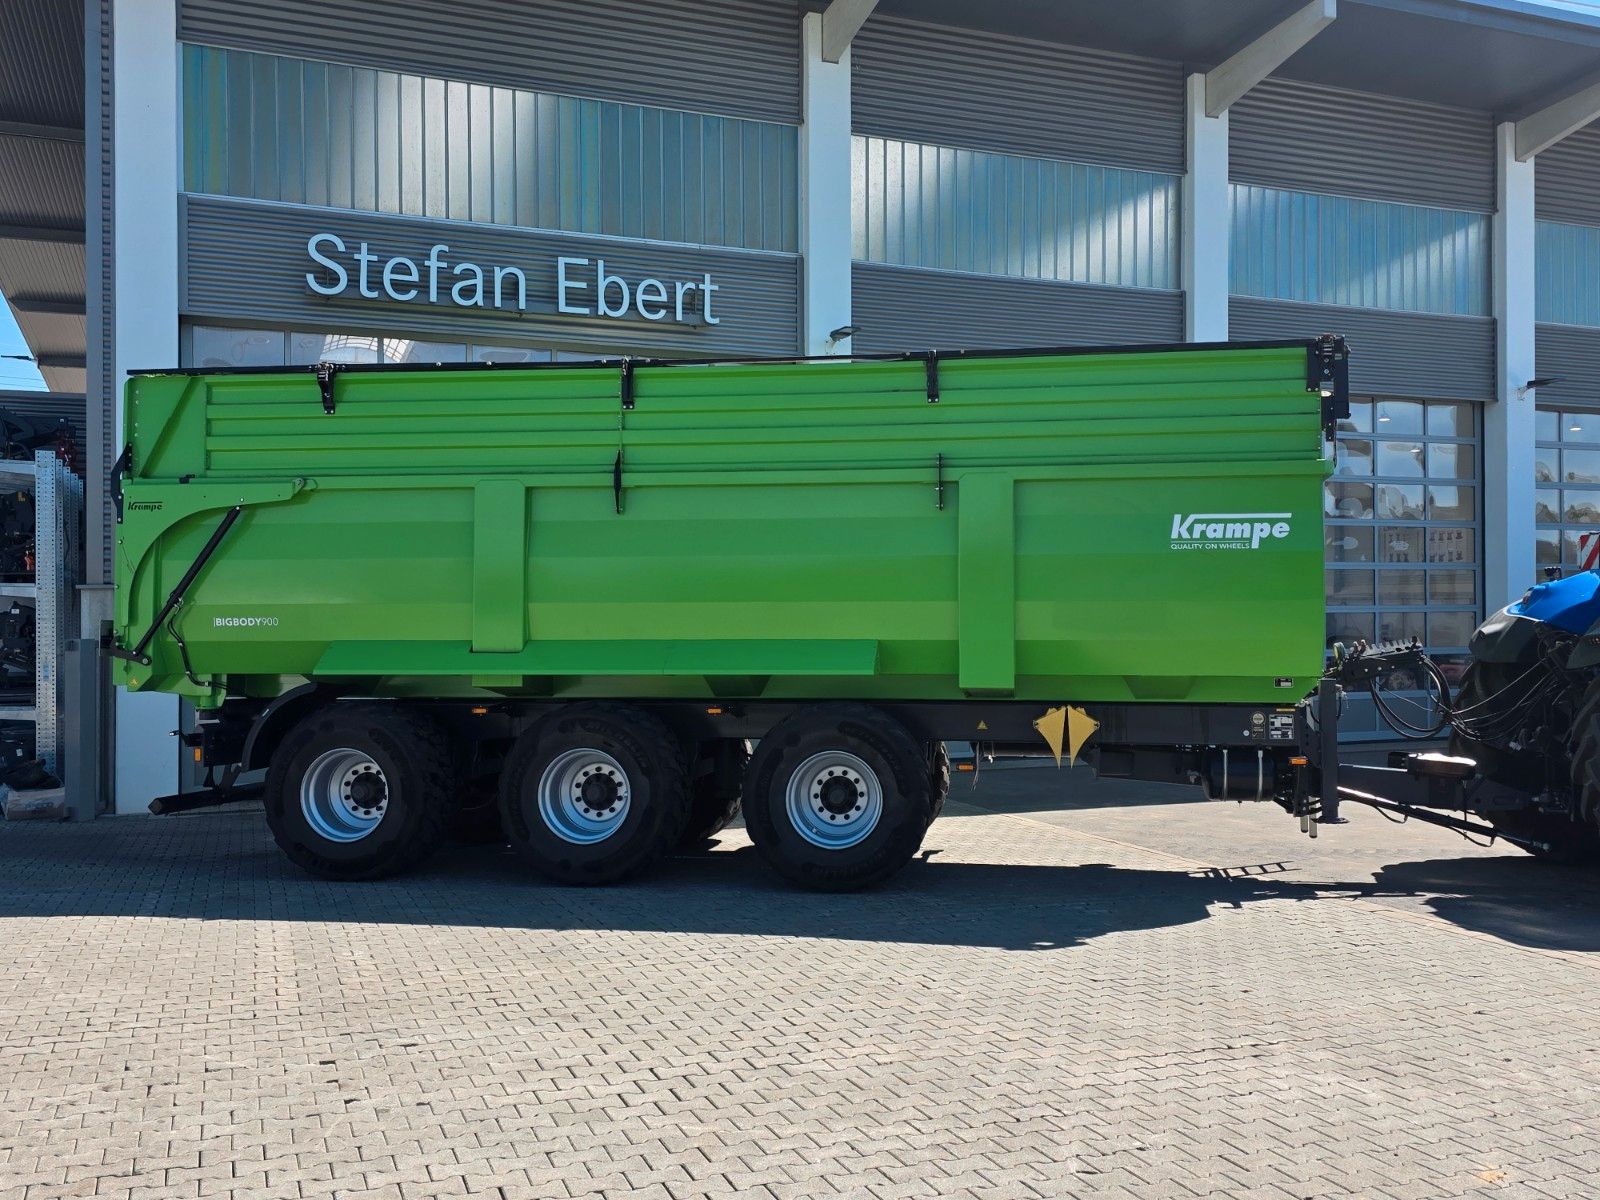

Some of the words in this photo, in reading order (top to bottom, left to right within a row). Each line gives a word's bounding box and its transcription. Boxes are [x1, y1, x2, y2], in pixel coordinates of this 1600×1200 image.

[305, 233, 526, 311] Stefan
[556, 256, 720, 325] Ebert
[127, 501, 163, 512] Krampe
[1170, 512, 1292, 549] Krampe
